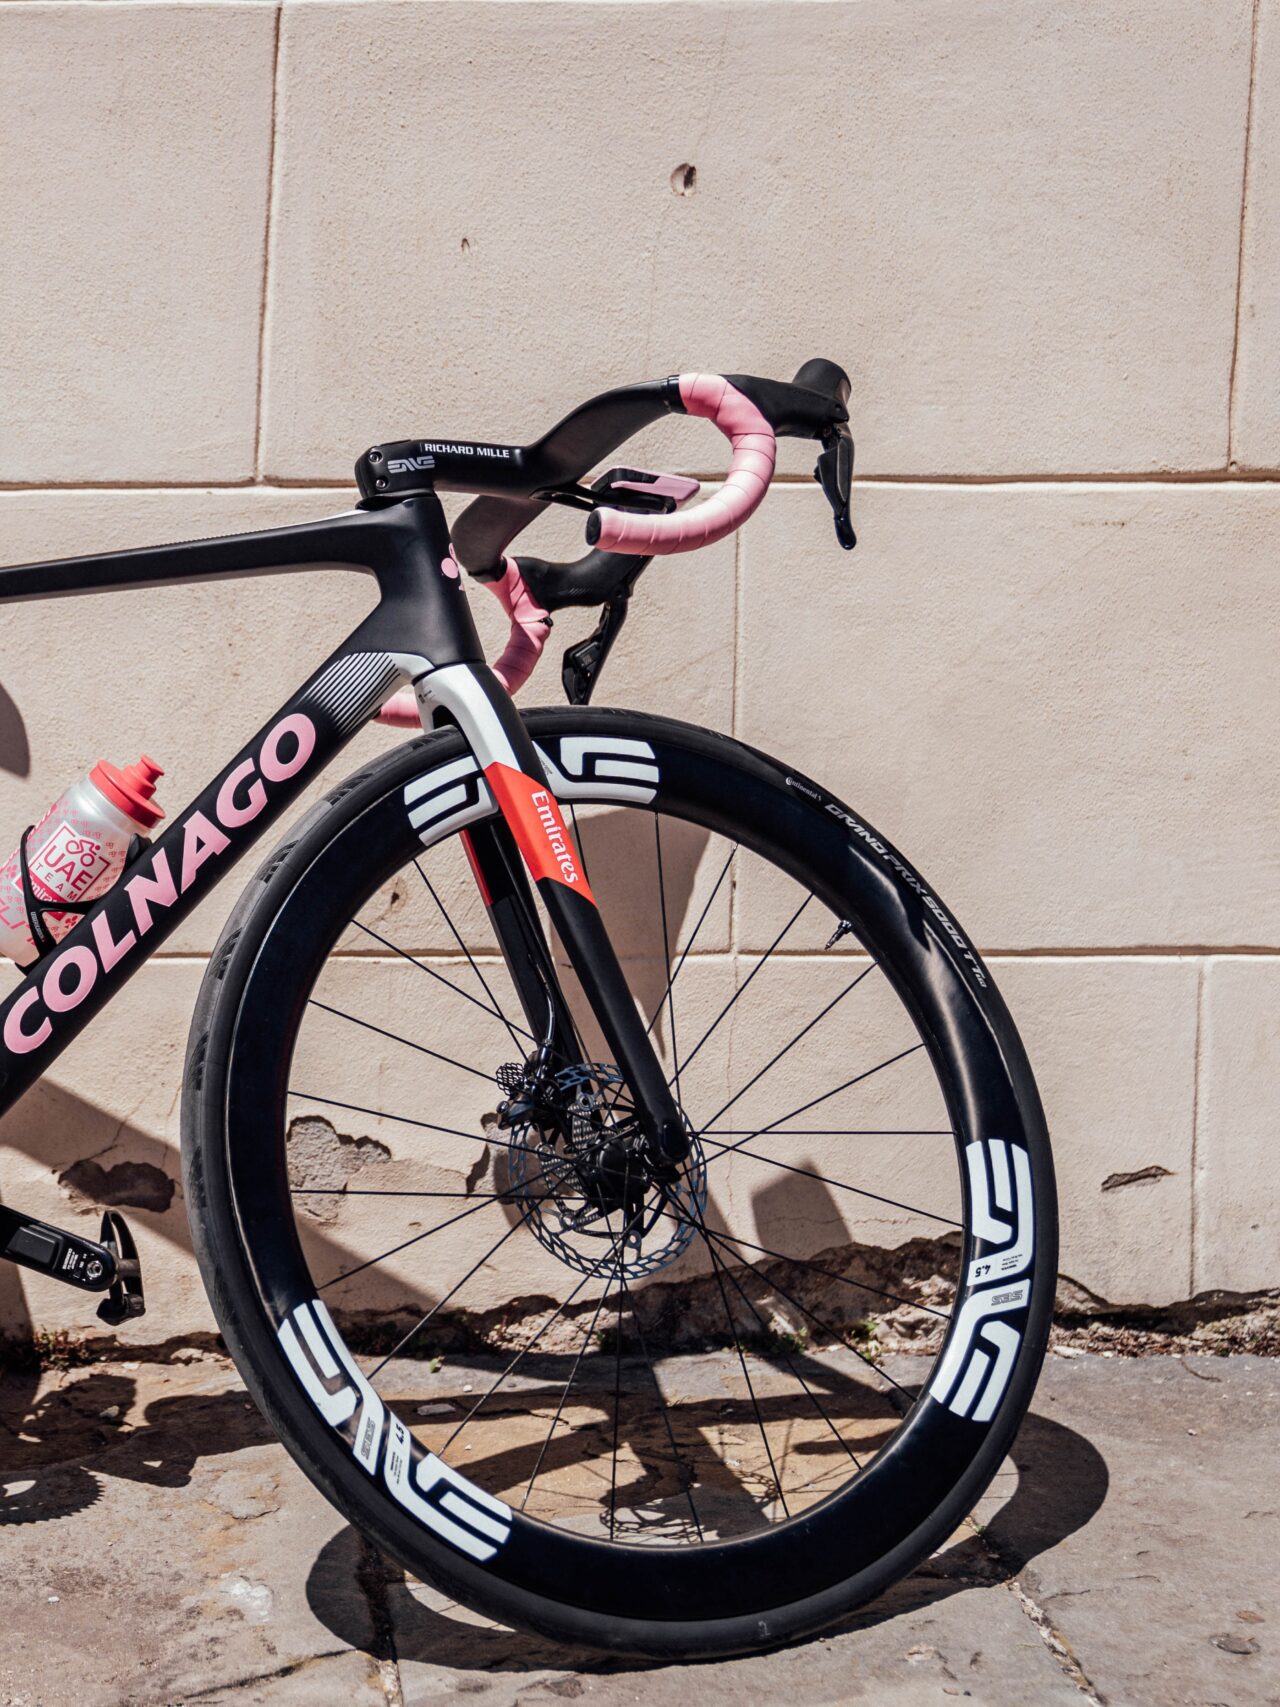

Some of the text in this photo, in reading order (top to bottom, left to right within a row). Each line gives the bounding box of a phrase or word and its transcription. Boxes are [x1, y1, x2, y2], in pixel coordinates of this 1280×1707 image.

[424, 443, 510, 458] RICHARD MILLE
[531, 789, 579, 884] Emirates
[3, 712, 316, 1055] COLNAGO
[36, 862, 78, 901] TEAM
[43, 845, 93, 891] UAE
[824, 803, 887, 854] GRAND
[883, 854, 927, 896] PRIX
[922, 895, 968, 949] 5000
[975, 1263, 992, 1278] 4.5
